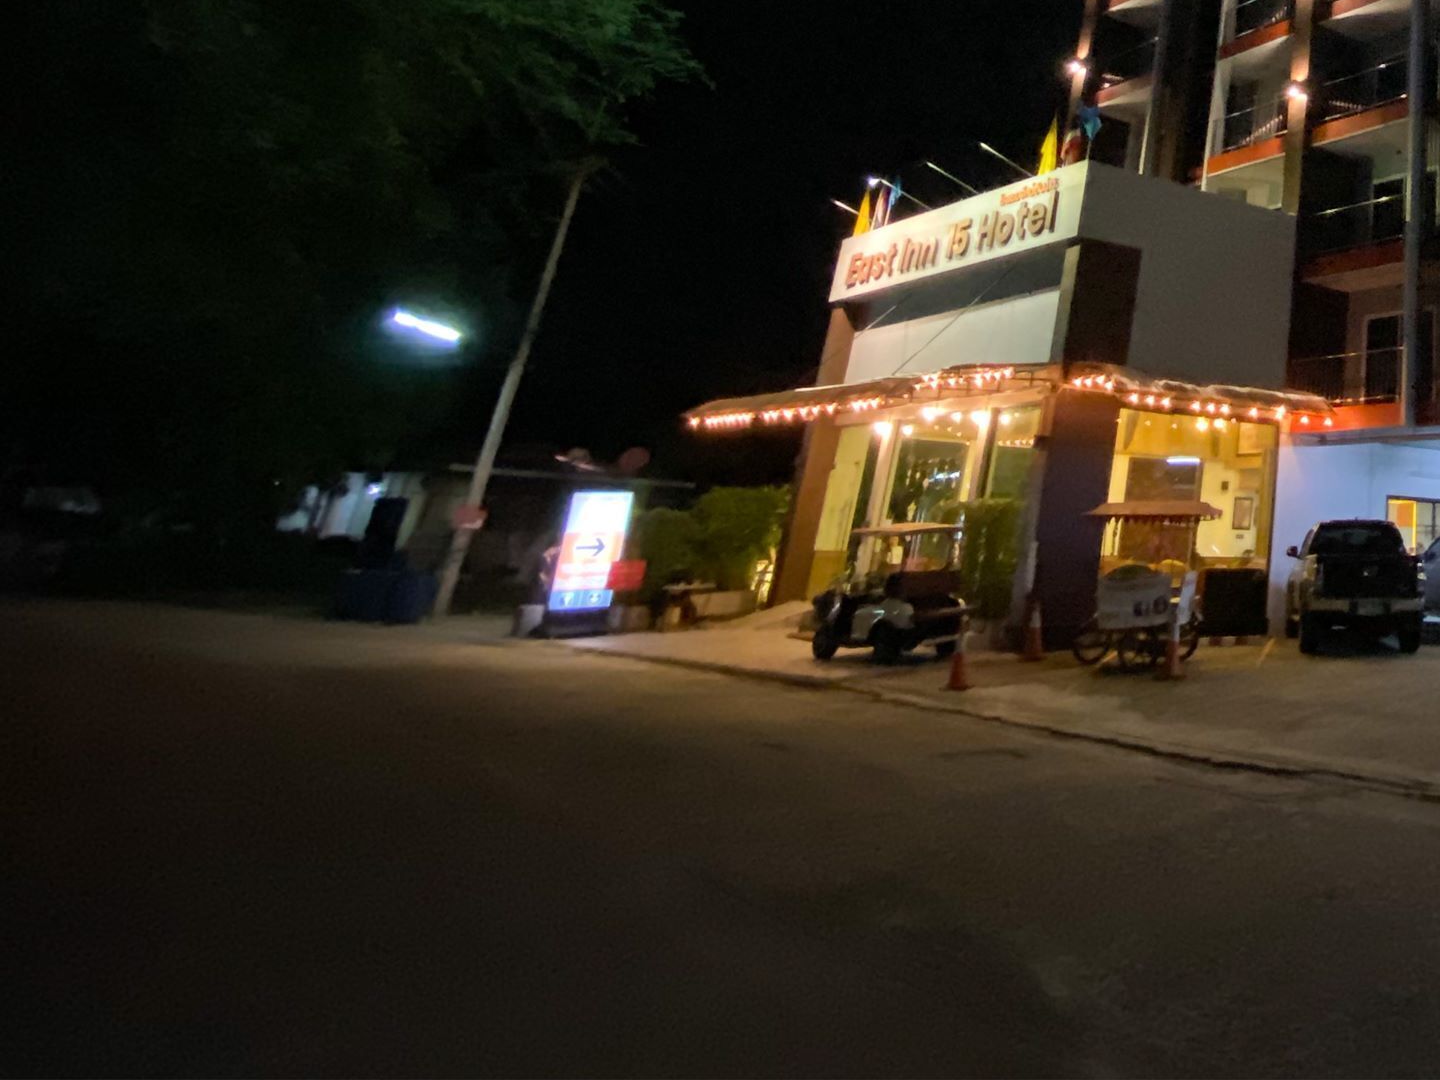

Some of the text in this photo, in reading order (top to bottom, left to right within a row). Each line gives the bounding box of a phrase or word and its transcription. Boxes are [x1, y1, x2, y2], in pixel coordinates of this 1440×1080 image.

[846, 242, 898, 289] East
[899, 235, 938, 274] Inn
[944, 217, 973, 261] 15
[977, 191, 1060, 252] Hotel
